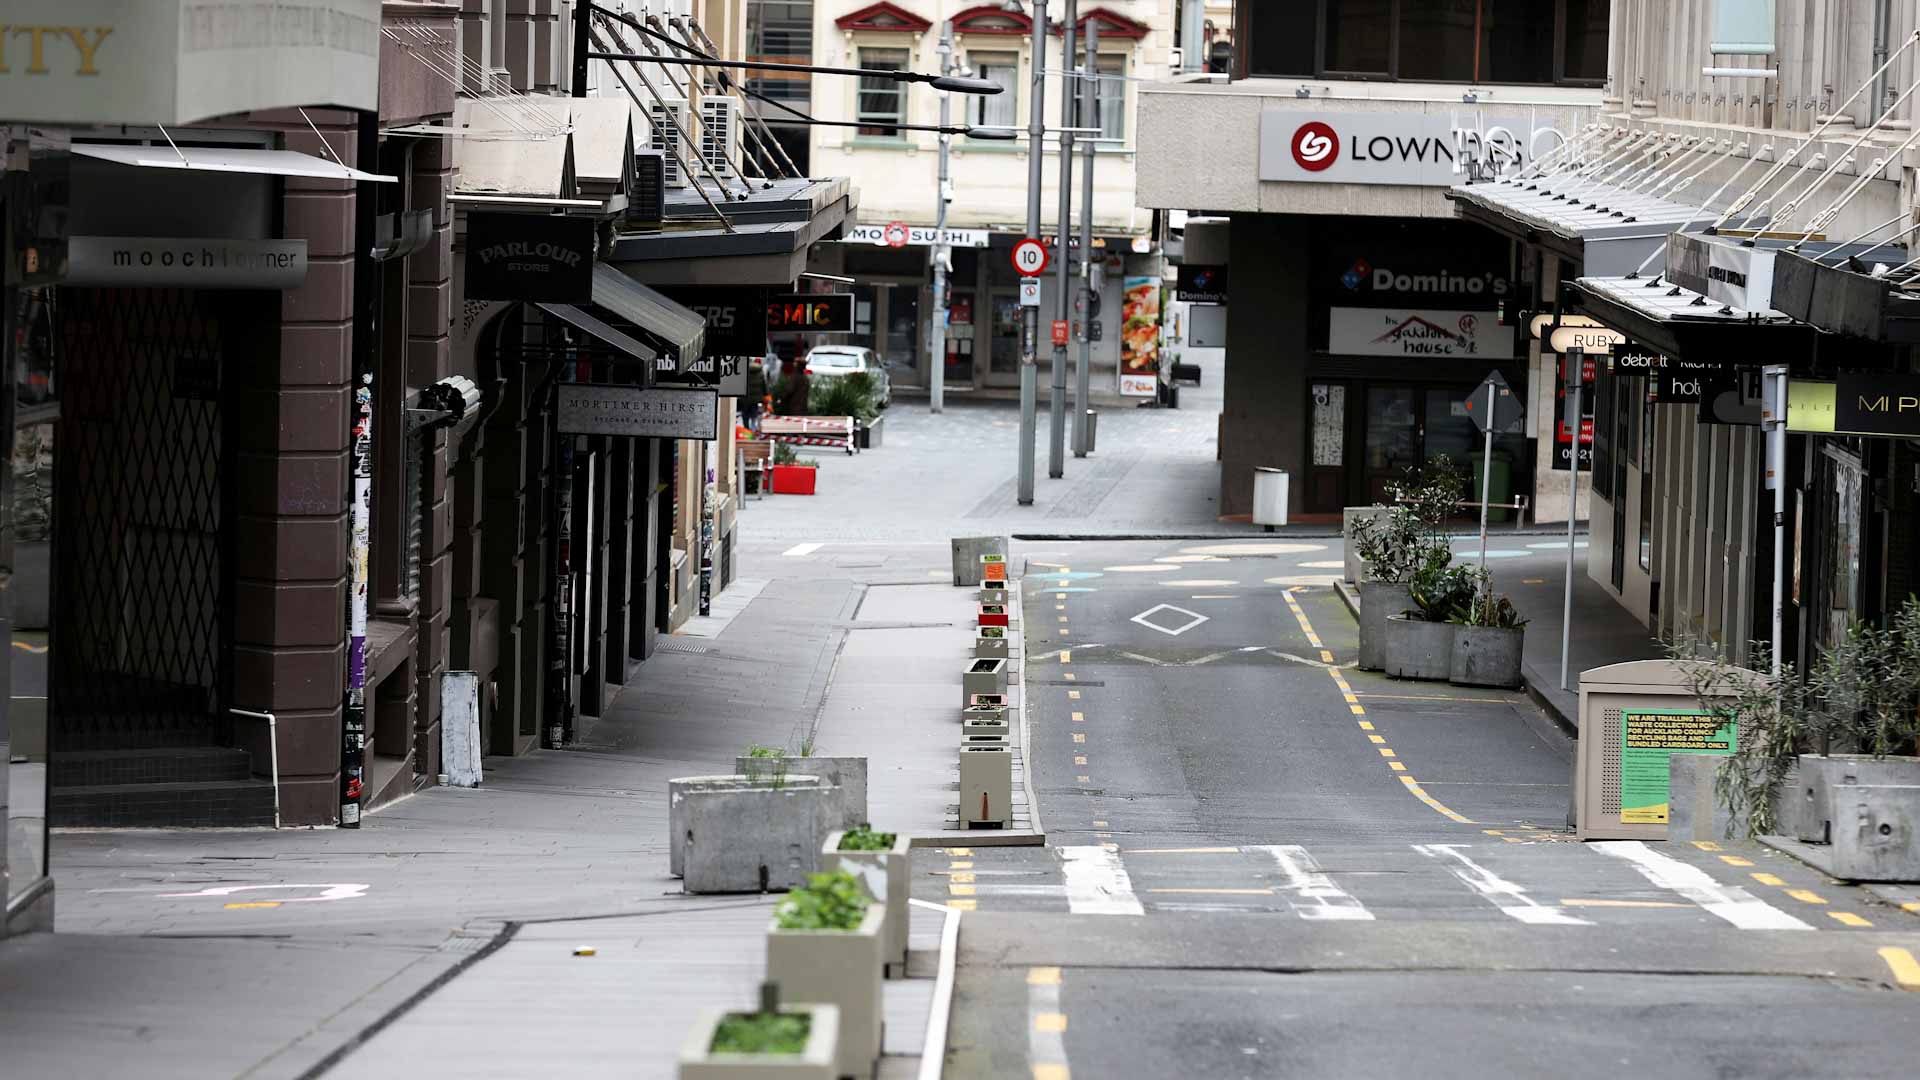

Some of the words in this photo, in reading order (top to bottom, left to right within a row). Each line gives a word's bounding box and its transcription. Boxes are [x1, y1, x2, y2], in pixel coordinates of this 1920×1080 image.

[479, 241, 581, 268] PARLOUR
[1022, 250, 1037, 265] 10
[507, 262, 550, 273] STORE
[1372, 268, 1508, 295] Domino's
[1404, 340, 1453, 355] house
[1574, 334, 1618, 348] RUBY
[1620, 352, 1669, 369] debrett
[1671, 377, 1700, 396] hot
[568, 399, 651, 411] MORTIMER
[659, 402, 705, 413] HIRST
[1858, 395, 1889, 412] MI
[1898, 396, 1920, 413] P
